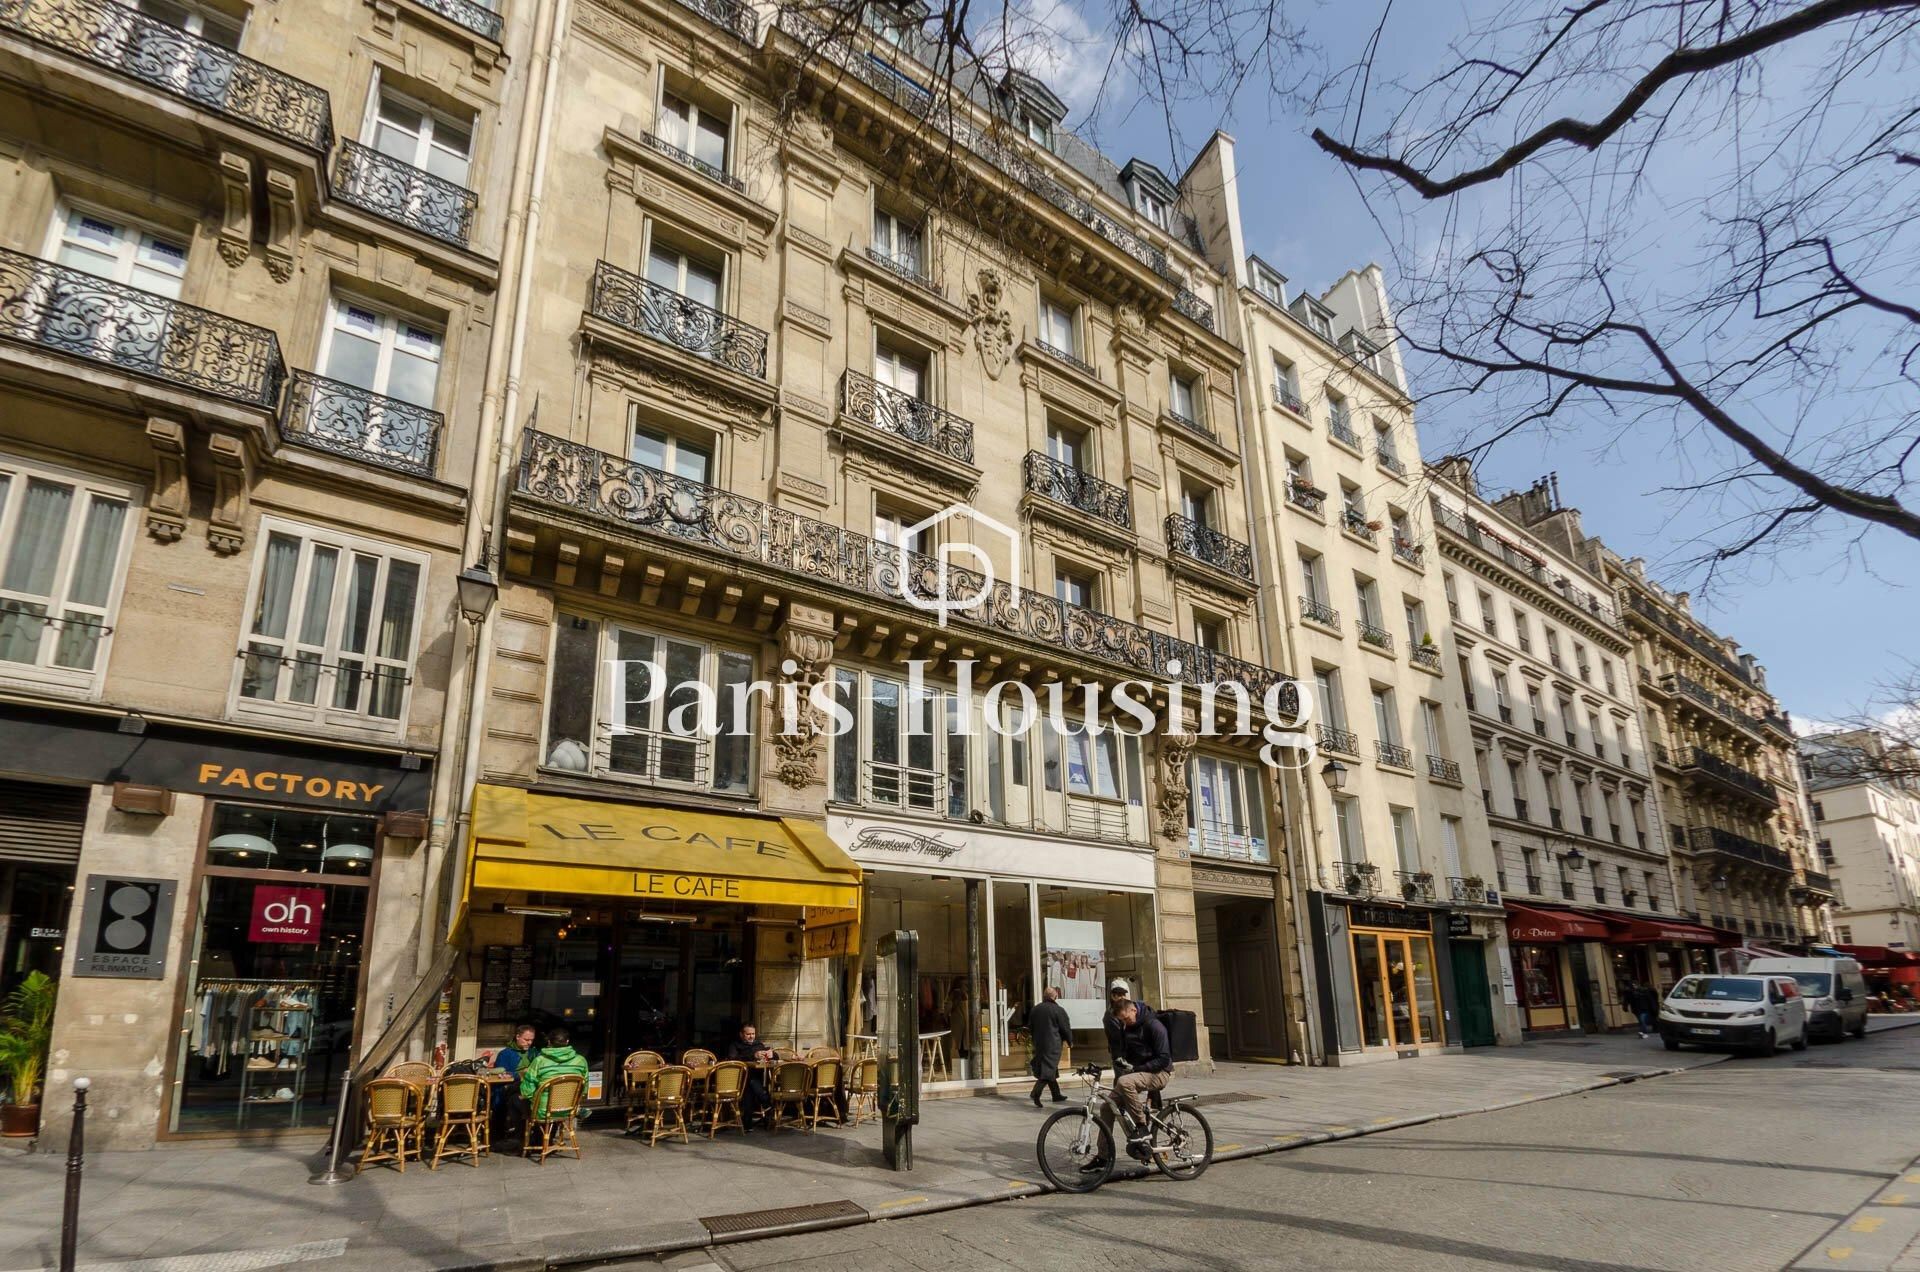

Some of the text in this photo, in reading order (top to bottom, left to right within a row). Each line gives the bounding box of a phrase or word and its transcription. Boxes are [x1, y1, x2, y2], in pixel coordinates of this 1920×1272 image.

[198, 764, 384, 802] FACTORY
[541, 823, 790, 859] LE CAFE
[849, 828, 964, 862] American Vintage
[633, 873, 740, 898] LE CAFE
[280, 926, 309, 935] history
[91, 964, 148, 974] KILIWATCH
[92, 955, 150, 964] ESPACE
